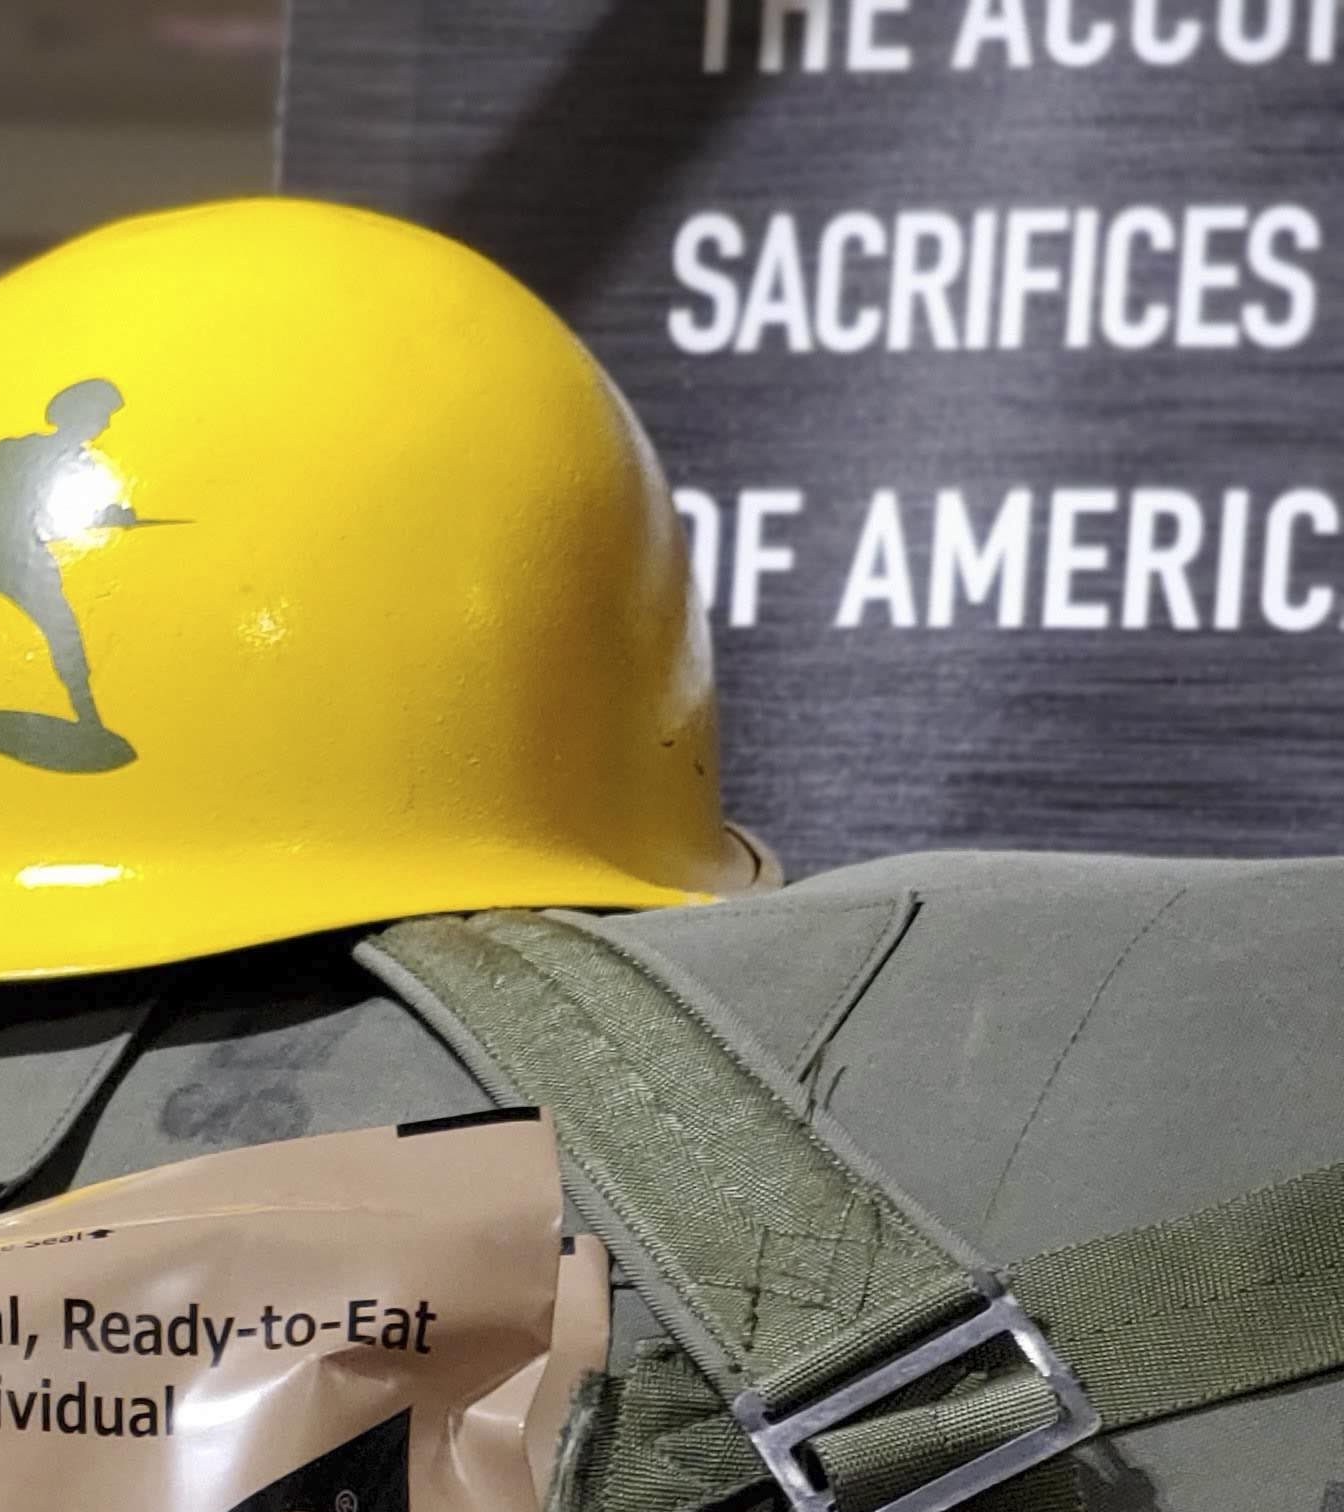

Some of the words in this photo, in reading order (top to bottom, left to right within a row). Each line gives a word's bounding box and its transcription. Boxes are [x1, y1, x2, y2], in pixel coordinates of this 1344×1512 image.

[667, 204, 1322, 354] SACRIFICES
[832, 487, 1344, 632] AMERIC
[63, 1298, 439, 1368] Ready-to-Eat
